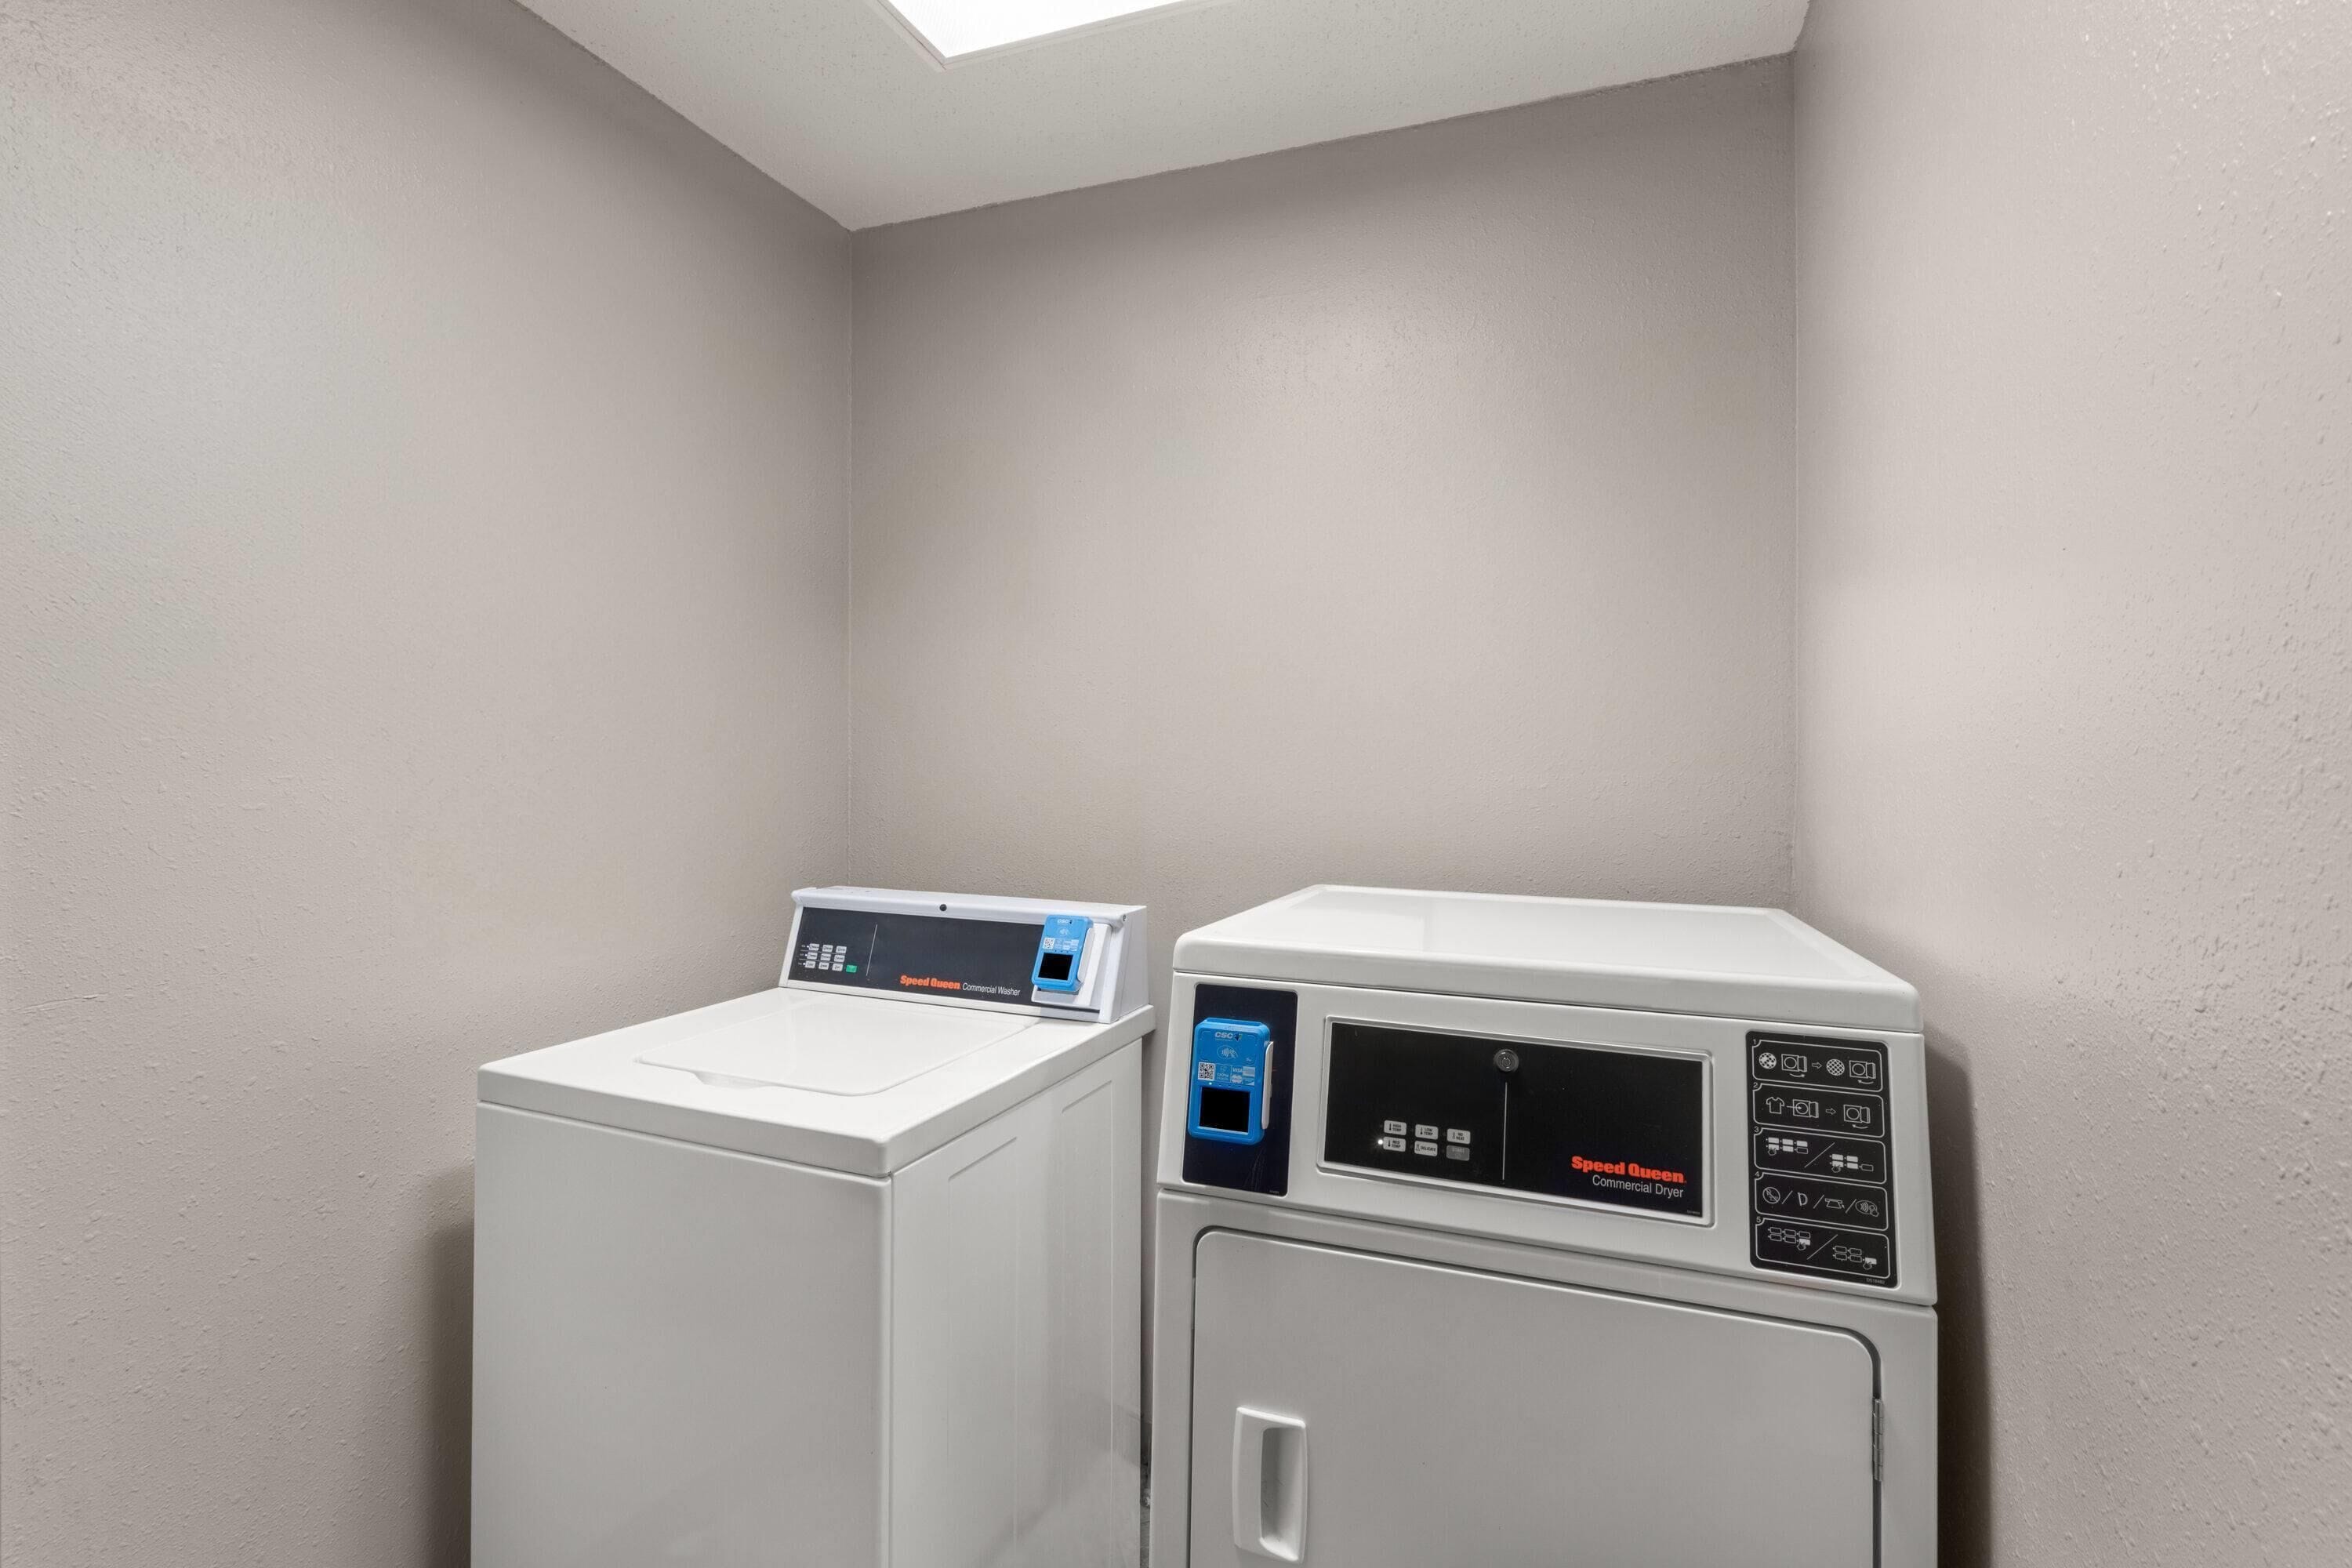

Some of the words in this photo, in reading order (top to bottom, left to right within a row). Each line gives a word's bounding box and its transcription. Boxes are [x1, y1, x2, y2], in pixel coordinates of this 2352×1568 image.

[900, 975, 929, 986] Speed
[931, 978, 960, 989] Queen
[962, 982, 996, 993] Commercial
[997, 986, 1021, 996] Washer
[1571, 1156, 1625, 1175] Speed
[1628, 1163, 1684, 1183] Queen
[1592, 1174, 1652, 1193] Commercial
[1655, 1183, 1684, 1199] Dryer
